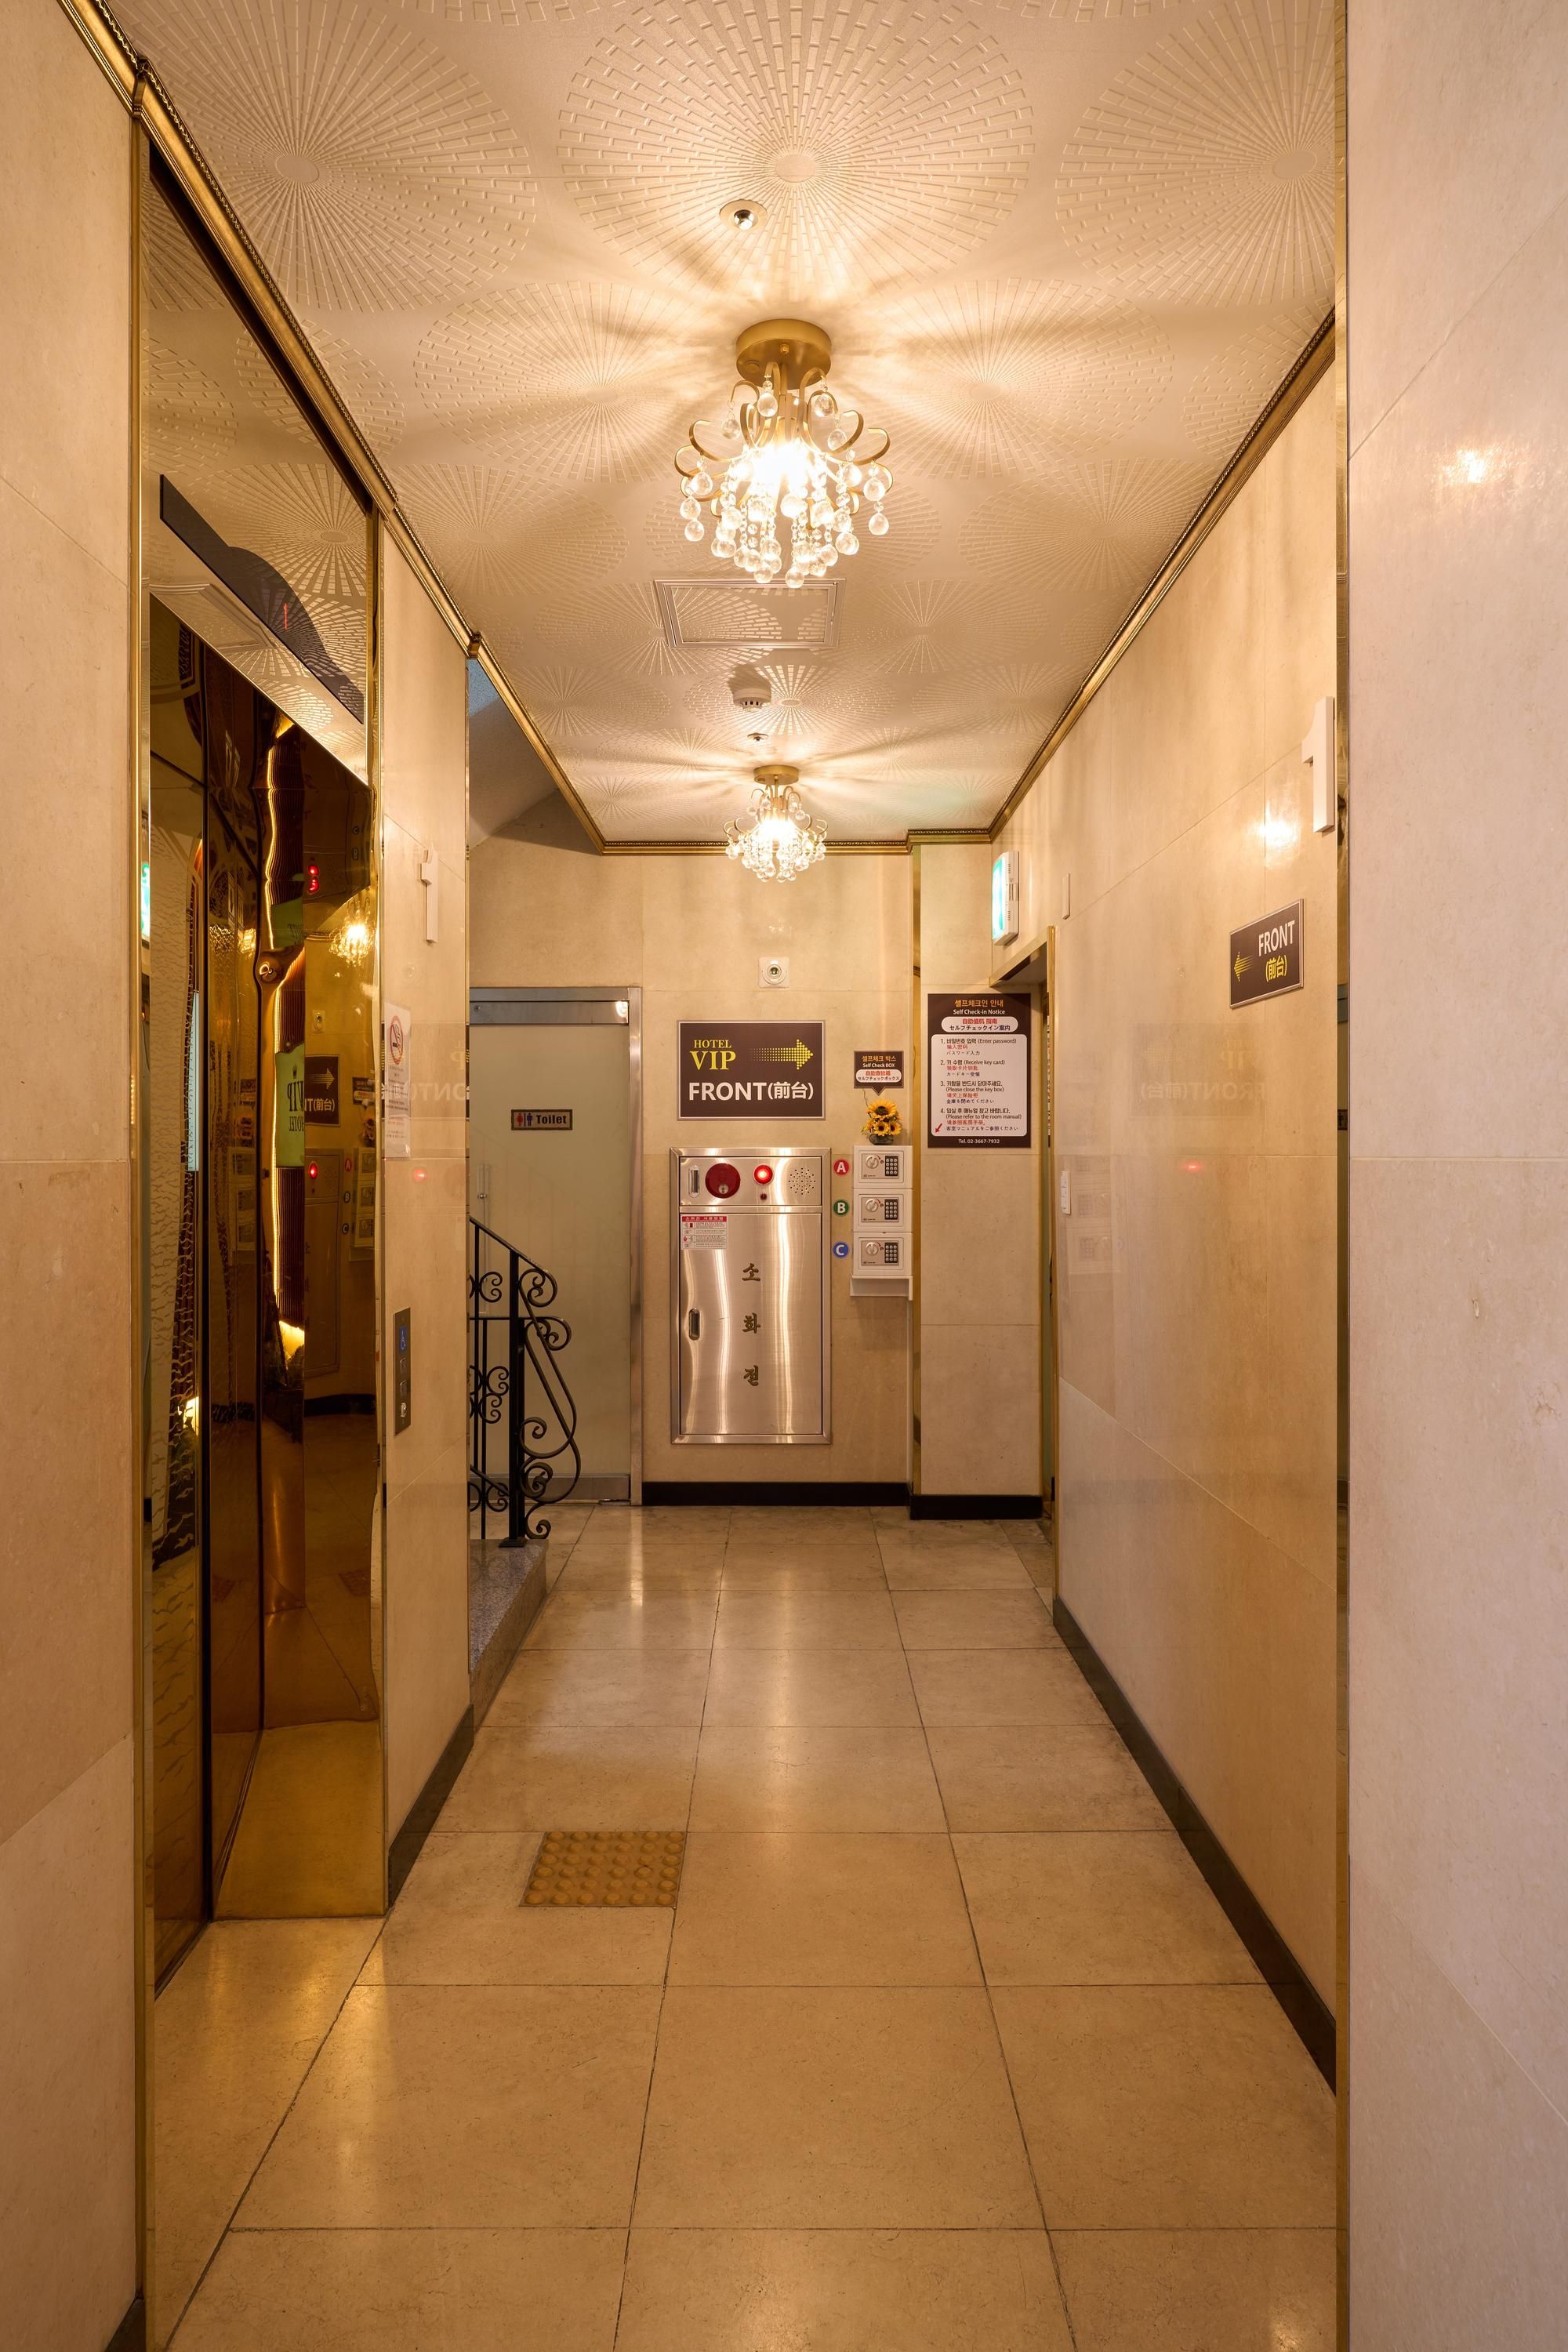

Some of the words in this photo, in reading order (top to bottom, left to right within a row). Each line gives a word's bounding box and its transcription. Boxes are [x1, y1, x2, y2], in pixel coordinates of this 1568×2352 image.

[1258, 920, 1295, 956] FRONT
[1265, 954, 1287, 982] (前台)
[954, 999, 988, 1007] 셀프체크인
[990, 999, 1004, 1007] 안내
[694, 1040, 731, 1048] HOTEL
[690, 1051, 736, 1070] VIP
[689, 1081, 814, 1101] FRONT(前台)
[535, 1115, 567, 1124] Toilet
[837, 1162, 847, 1173] A
[837, 1202, 846, 1214] B
[836, 1244, 844, 1256] C
